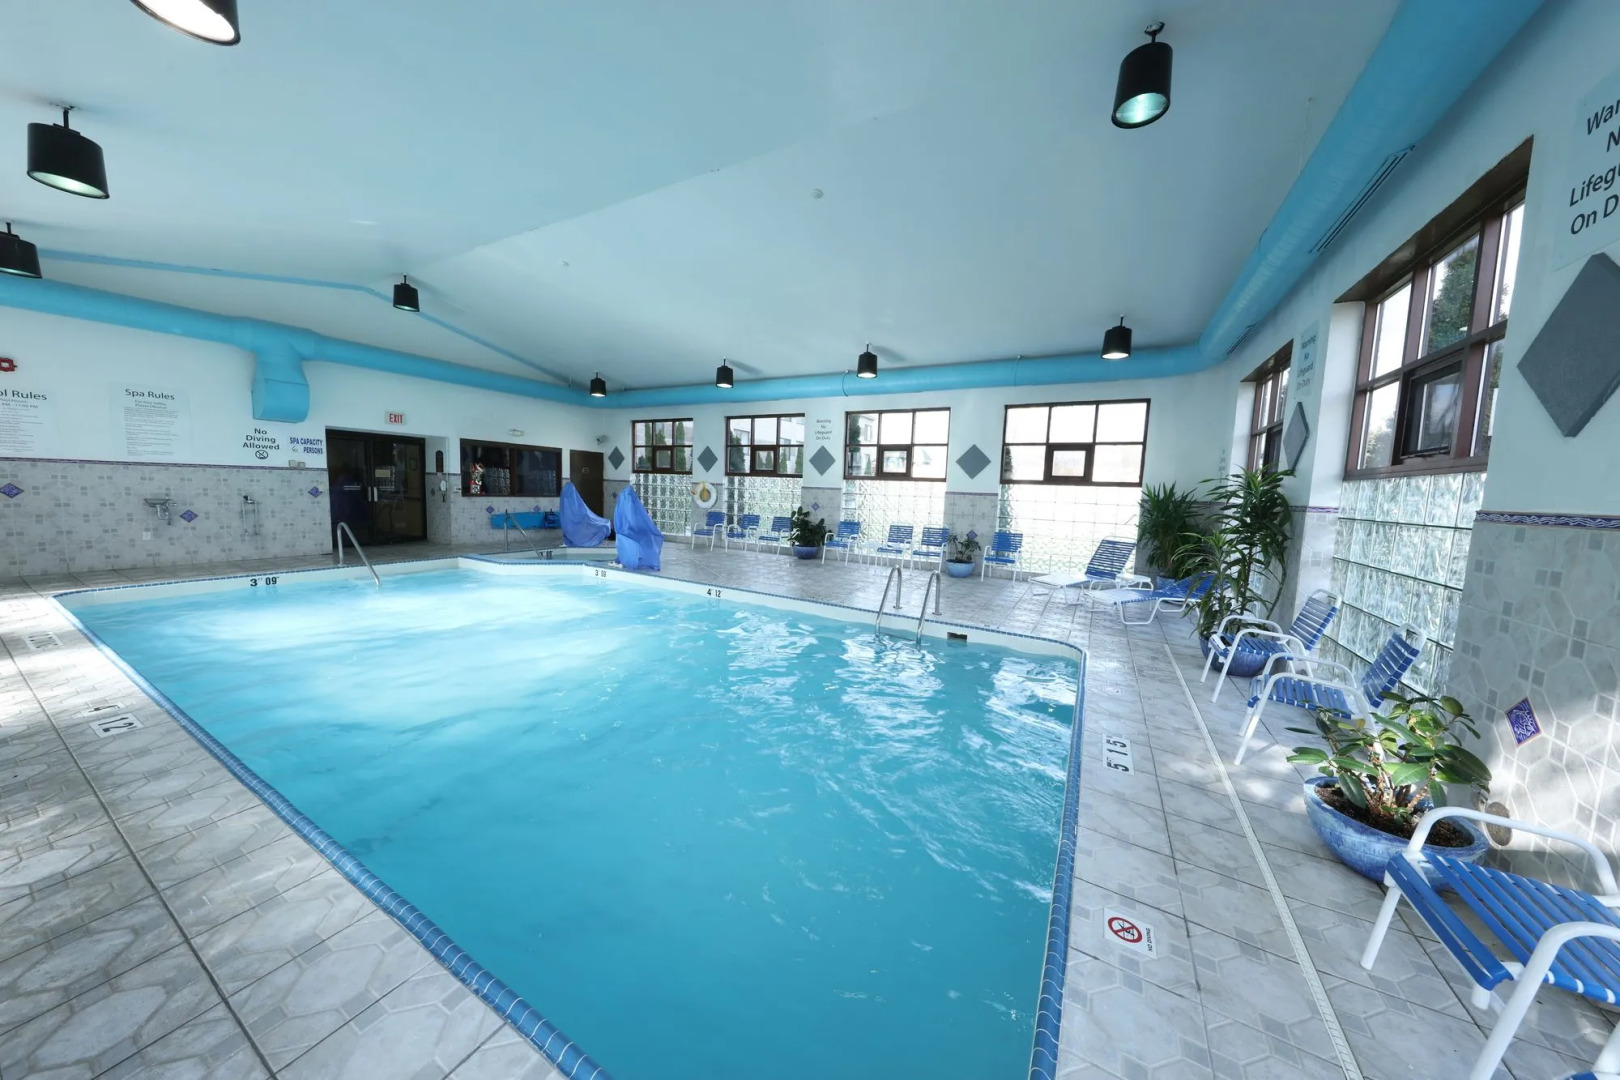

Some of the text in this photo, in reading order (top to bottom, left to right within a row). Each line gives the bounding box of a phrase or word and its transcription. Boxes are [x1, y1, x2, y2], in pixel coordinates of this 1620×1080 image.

[1569, 162, 1620, 208] Lifeg
[1570, 209, 1598, 236] On
[12, 389, 48, 401] Rules
[124, 388, 175, 401] Spa Rules
[389, 413, 404, 424] EXIT
[254, 427, 268, 435] No
[245, 434, 276, 444] Diving
[289, 437, 323, 447] SPA CAPACITY
[242, 442, 280, 451] Allowed
[303, 446, 324, 455] PERSONS
[594, 569, 599, 577] 3
[250, 576, 277, 587] 3 09
[707, 588, 722, 598] 4 12
[1106, 761, 1130, 773] 5
[1145, 927, 1153, 952] NO DIVING
